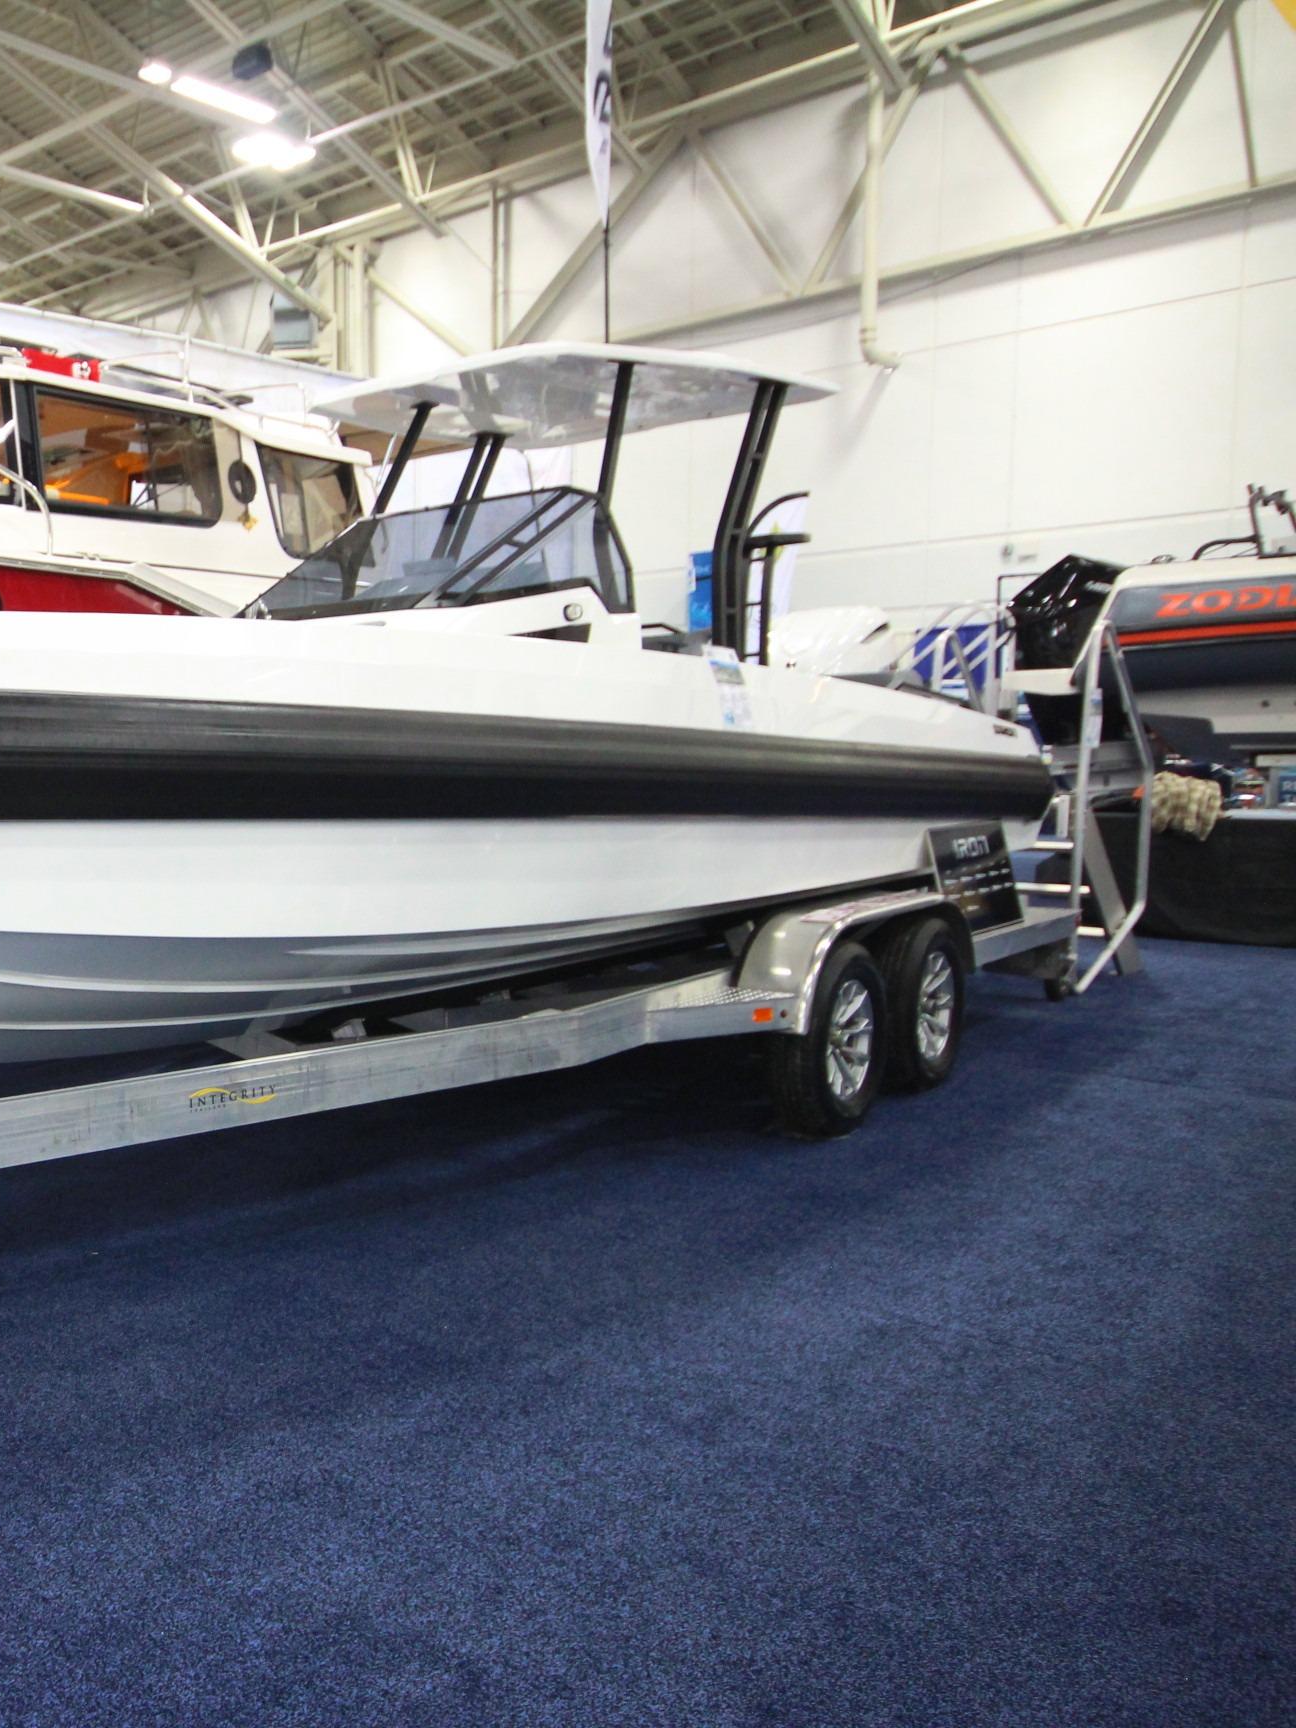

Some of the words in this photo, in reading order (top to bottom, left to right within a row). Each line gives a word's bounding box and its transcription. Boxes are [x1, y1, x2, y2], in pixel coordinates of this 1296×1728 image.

[1156, 584, 1296, 618] ZODI
[952, 835, 990, 859] IRON
[189, 1084, 276, 1108] INTEGRITY
